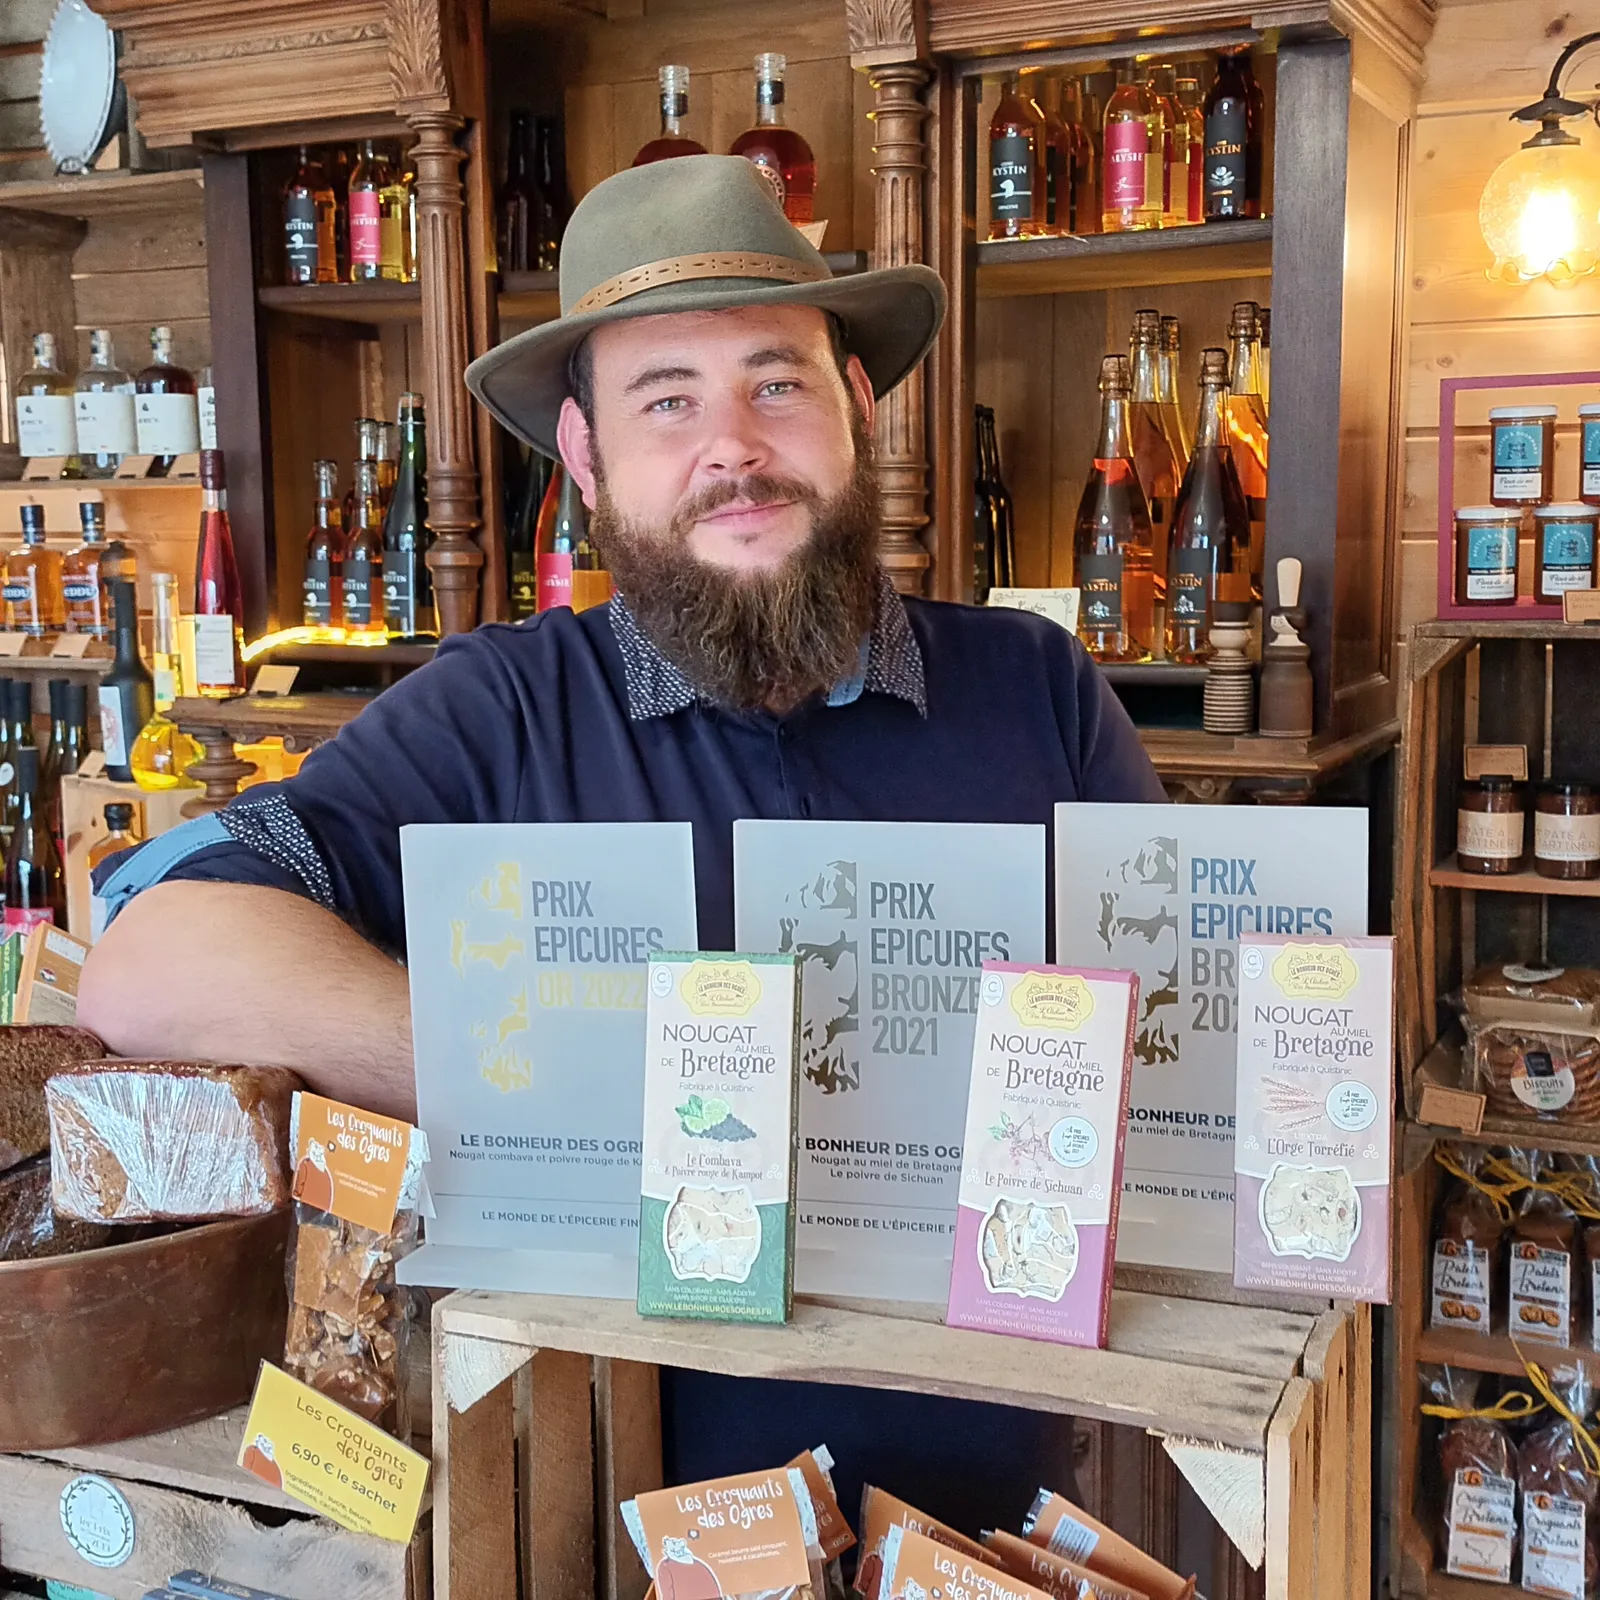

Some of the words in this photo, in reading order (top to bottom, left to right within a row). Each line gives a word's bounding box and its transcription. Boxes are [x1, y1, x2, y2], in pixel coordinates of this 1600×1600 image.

[1190, 858, 1258, 896] PRIX
[531, 880, 594, 918] PRIX
[870, 881, 936, 920] PRIX
[1191, 903, 1334, 940] EPICURES
[534, 926, 663, 964] EPICURES
[870, 928, 1010, 967] EPICURES
[1247, 954, 1258, 966] C
[656, 972, 667, 984] C
[987, 981, 998, 993] C
[538, 973, 575, 1007] OR
[581, 974, 647, 1010] 2022
[872, 973, 981, 1014] BRONZE
[1254, 1005, 1353, 1027] NOUGAT
[663, 1024, 757, 1044] NOUGAT
[872, 1015, 938, 1056] 2021
[1330, 1027, 1345, 1037] AU
[1347, 1028, 1371, 1038] MIEL
[735, 1045, 750, 1054] AU
[751, 1045, 774, 1055] MIEL
[990, 1033, 1087, 1060] NOUGAT
[1253, 1038, 1267, 1048] DE
[1274, 1029, 1373, 1062] Bretagne
[661, 1058, 675, 1067] DE
[681, 1048, 776, 1080] Bretagne
[1062, 1059, 1077, 1069] AU
[1079, 1061, 1103, 1072] MIEL
[1273, 1062, 1309, 1073] Fabriqué
[1316, 1064, 1352, 1075] Quistinic
[679, 1083, 714, 1093] Fabriqué
[715, 1084, 720, 1092] à
[721, 1084, 755, 1093] Quistinic
[987, 1067, 1000, 1077] DE
[1005, 1058, 1104, 1096] Bretagne
[1003, 1093, 1039, 1105] Fabriqué
[1046, 1097, 1082, 1110] Quistinic
[327, 1105, 345, 1128] Les
[348, 1112, 403, 1147] Croquants
[1128, 1108, 1210, 1127] BONHEUR
[1130, 1126, 1143, 1134] au
[1146, 1126, 1169, 1136] miel
[1172, 1128, 1186, 1138] de
[337, 1129, 356, 1151] des
[359, 1138, 390, 1163] Ogres
[460, 1134, 480, 1147] LE
[484, 1135, 563, 1150] BONHEUR
[567, 1138, 599, 1151] DES
[603, 1140, 643, 1154] OGR
[805, 1138, 890, 1155] BONHEUR
[895, 1143, 930, 1157] DES
[934, 1145, 963, 1159] OG
[1267, 1138, 1304, 1157] L'Orge
[1308, 1141, 1355, 1158] Torréfié
[449, 1150, 486, 1163] Nougat
[488, 1151, 533, 1162] combava
[536, 1154, 546, 1163] et
[549, 1154, 581, 1165] poivre
[584, 1157, 614, 1167] rouge
[617, 1156, 630, 1166] de
[687, 1153, 697, 1168] Le
[699, 1153, 742, 1168] Combava
[811, 1155, 850, 1167] Nougat
[854, 1159, 867, 1167] au
[870, 1158, 893, 1168] miel
[896, 1160, 910, 1170] de
[913, 1160, 963, 1173] Bretagne
[672, 1166, 696, 1178] Poivre
[698, 1169, 719, 1179] rouge
[721, 1167, 730, 1178] de
[732, 1168, 763, 1181] Kampot
[830, 1168, 843, 1178] Le
[846, 1170, 881, 1181] poivre
[884, 1171, 898, 1181] de
[901, 1172, 944, 1185] Sichuan
[985, 1171, 995, 1187] Le
[997, 1172, 1027, 1189] Poivre
[1029, 1176, 1042, 1190] de
[1044, 1179, 1083, 1195] Sichuan
[1135, 1184, 1178, 1197] MONDE
[1181, 1189, 1198, 1199] DE
[482, 1211, 495, 1220] LE
[497, 1212, 538, 1223] MONDE
[541, 1214, 556, 1224] DE
[558, 1214, 617, 1227] L'ÉPICERIE
[620, 1218, 641, 1229] FIN
[800, 1214, 814, 1224] LE
[817, 1216, 860, 1228] MONDE
[863, 1219, 879, 1229] DE
[882, 1218, 946, 1233] L'ÉPICERIE
[296, 1396, 322, 1422] Les
[326, 1415, 408, 1473] Croquants
[336, 1439, 360, 1464] des
[364, 1456, 404, 1490] Ogres
[291, 1443, 321, 1466] 6,90
[324, 1461, 335, 1475] €
[336, 1469, 349, 1484] le
[351, 1479, 397, 1514] sachet
[676, 1495, 702, 1513] Les
[706, 1476, 784, 1509] Croquants
[697, 1508, 725, 1529] des
[730, 1503, 774, 1530] Ogres
[934, 1550, 957, 1577] Les
[1031, 1553, 1054, 1579] Les
